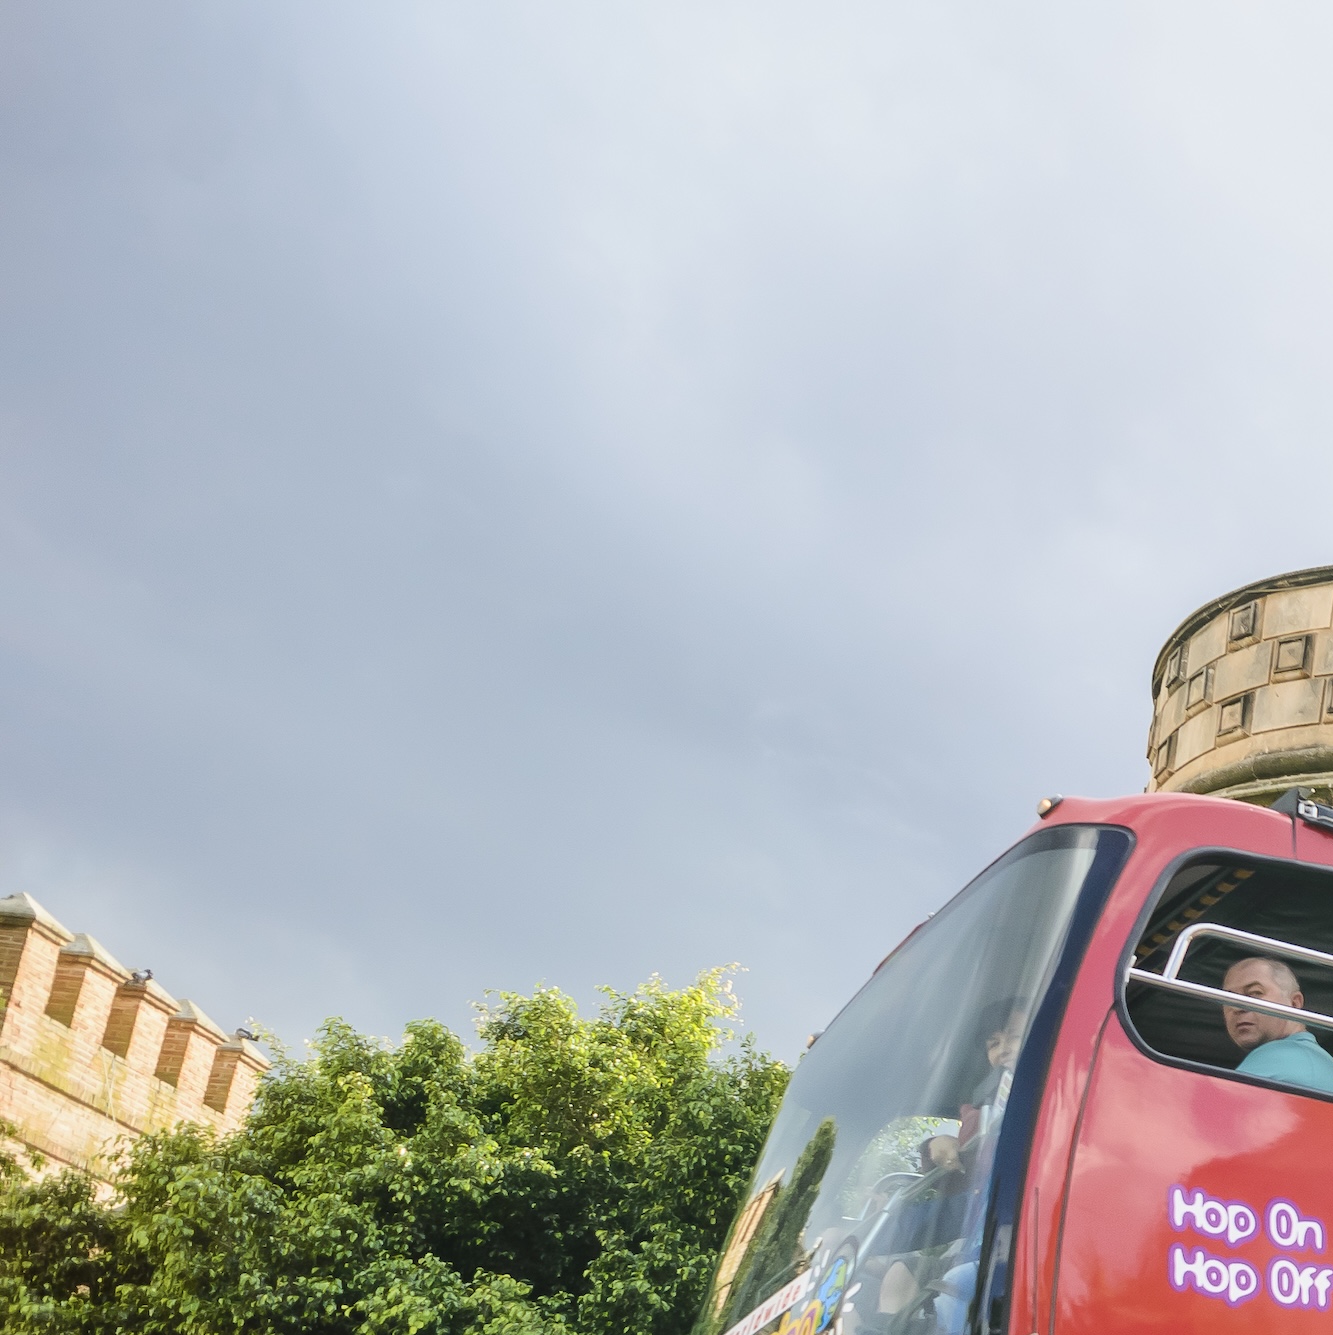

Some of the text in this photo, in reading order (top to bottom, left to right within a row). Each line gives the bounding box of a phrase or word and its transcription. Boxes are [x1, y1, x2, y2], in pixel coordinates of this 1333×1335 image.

[1171, 1186, 1326, 1252] Hop On
[1171, 1245, 1261, 1304] Hop
